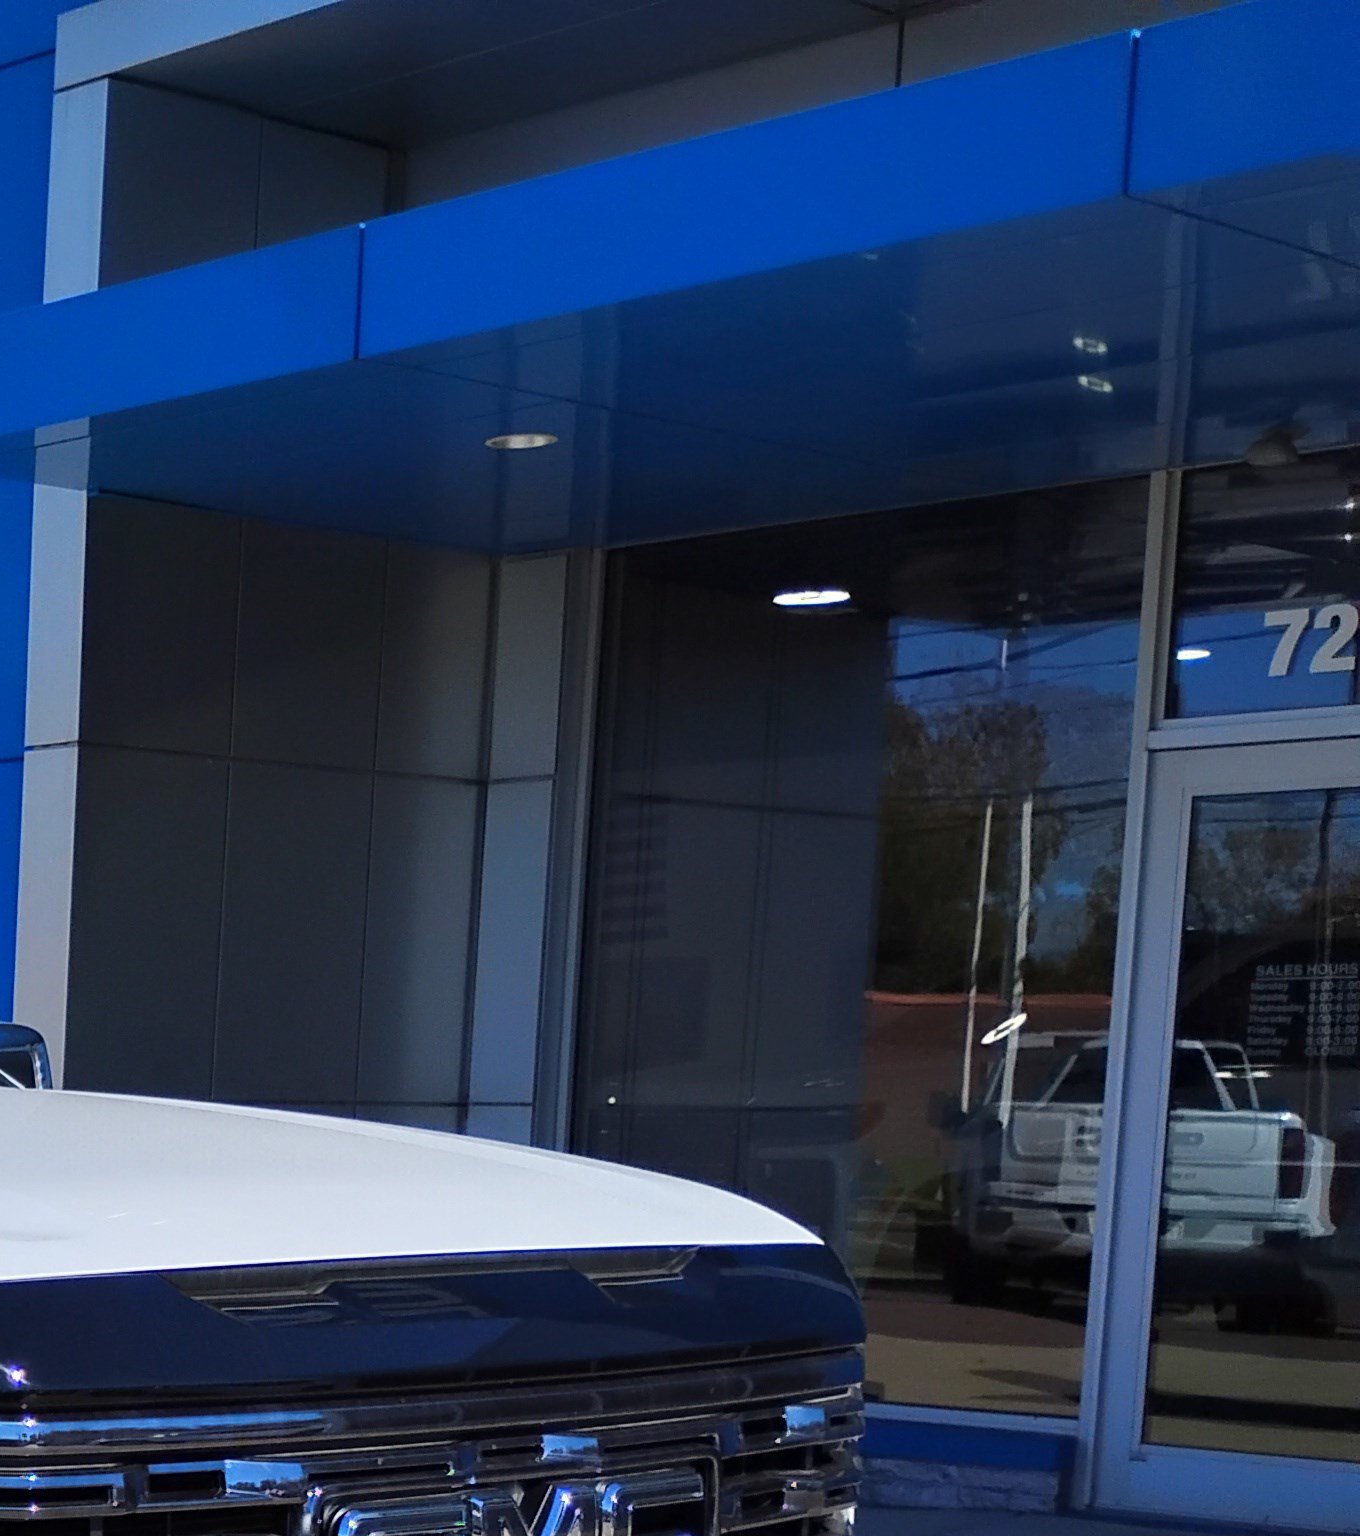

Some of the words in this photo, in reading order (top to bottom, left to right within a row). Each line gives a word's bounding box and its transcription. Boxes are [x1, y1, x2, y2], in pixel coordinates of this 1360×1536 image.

[1264, 604, 1359, 677] 72
[1256, 964, 1303, 977] SALES
[1306, 962, 1359, 975] HOURS
